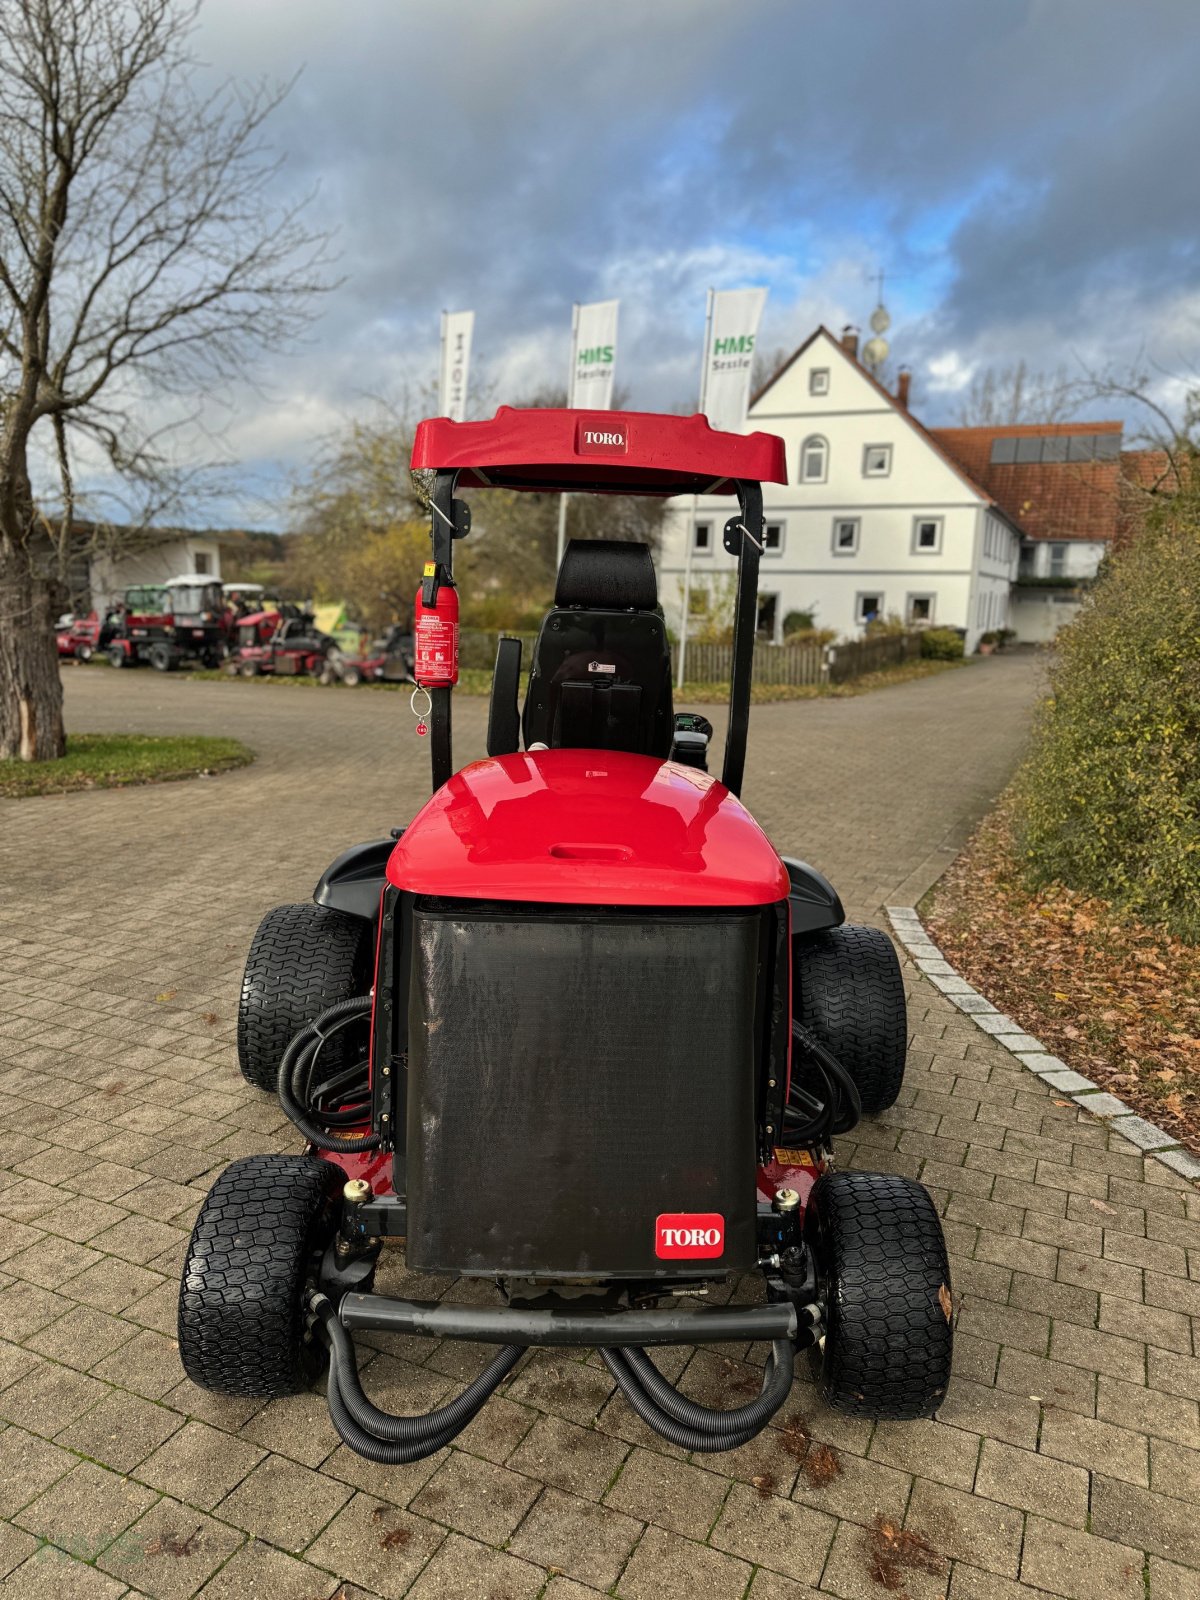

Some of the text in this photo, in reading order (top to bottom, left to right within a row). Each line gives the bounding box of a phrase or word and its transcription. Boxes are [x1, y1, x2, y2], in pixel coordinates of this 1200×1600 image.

[577, 345, 614, 366] HMS
[713, 334, 755, 356] HMS
[661, 1228, 721, 1247] TORO
